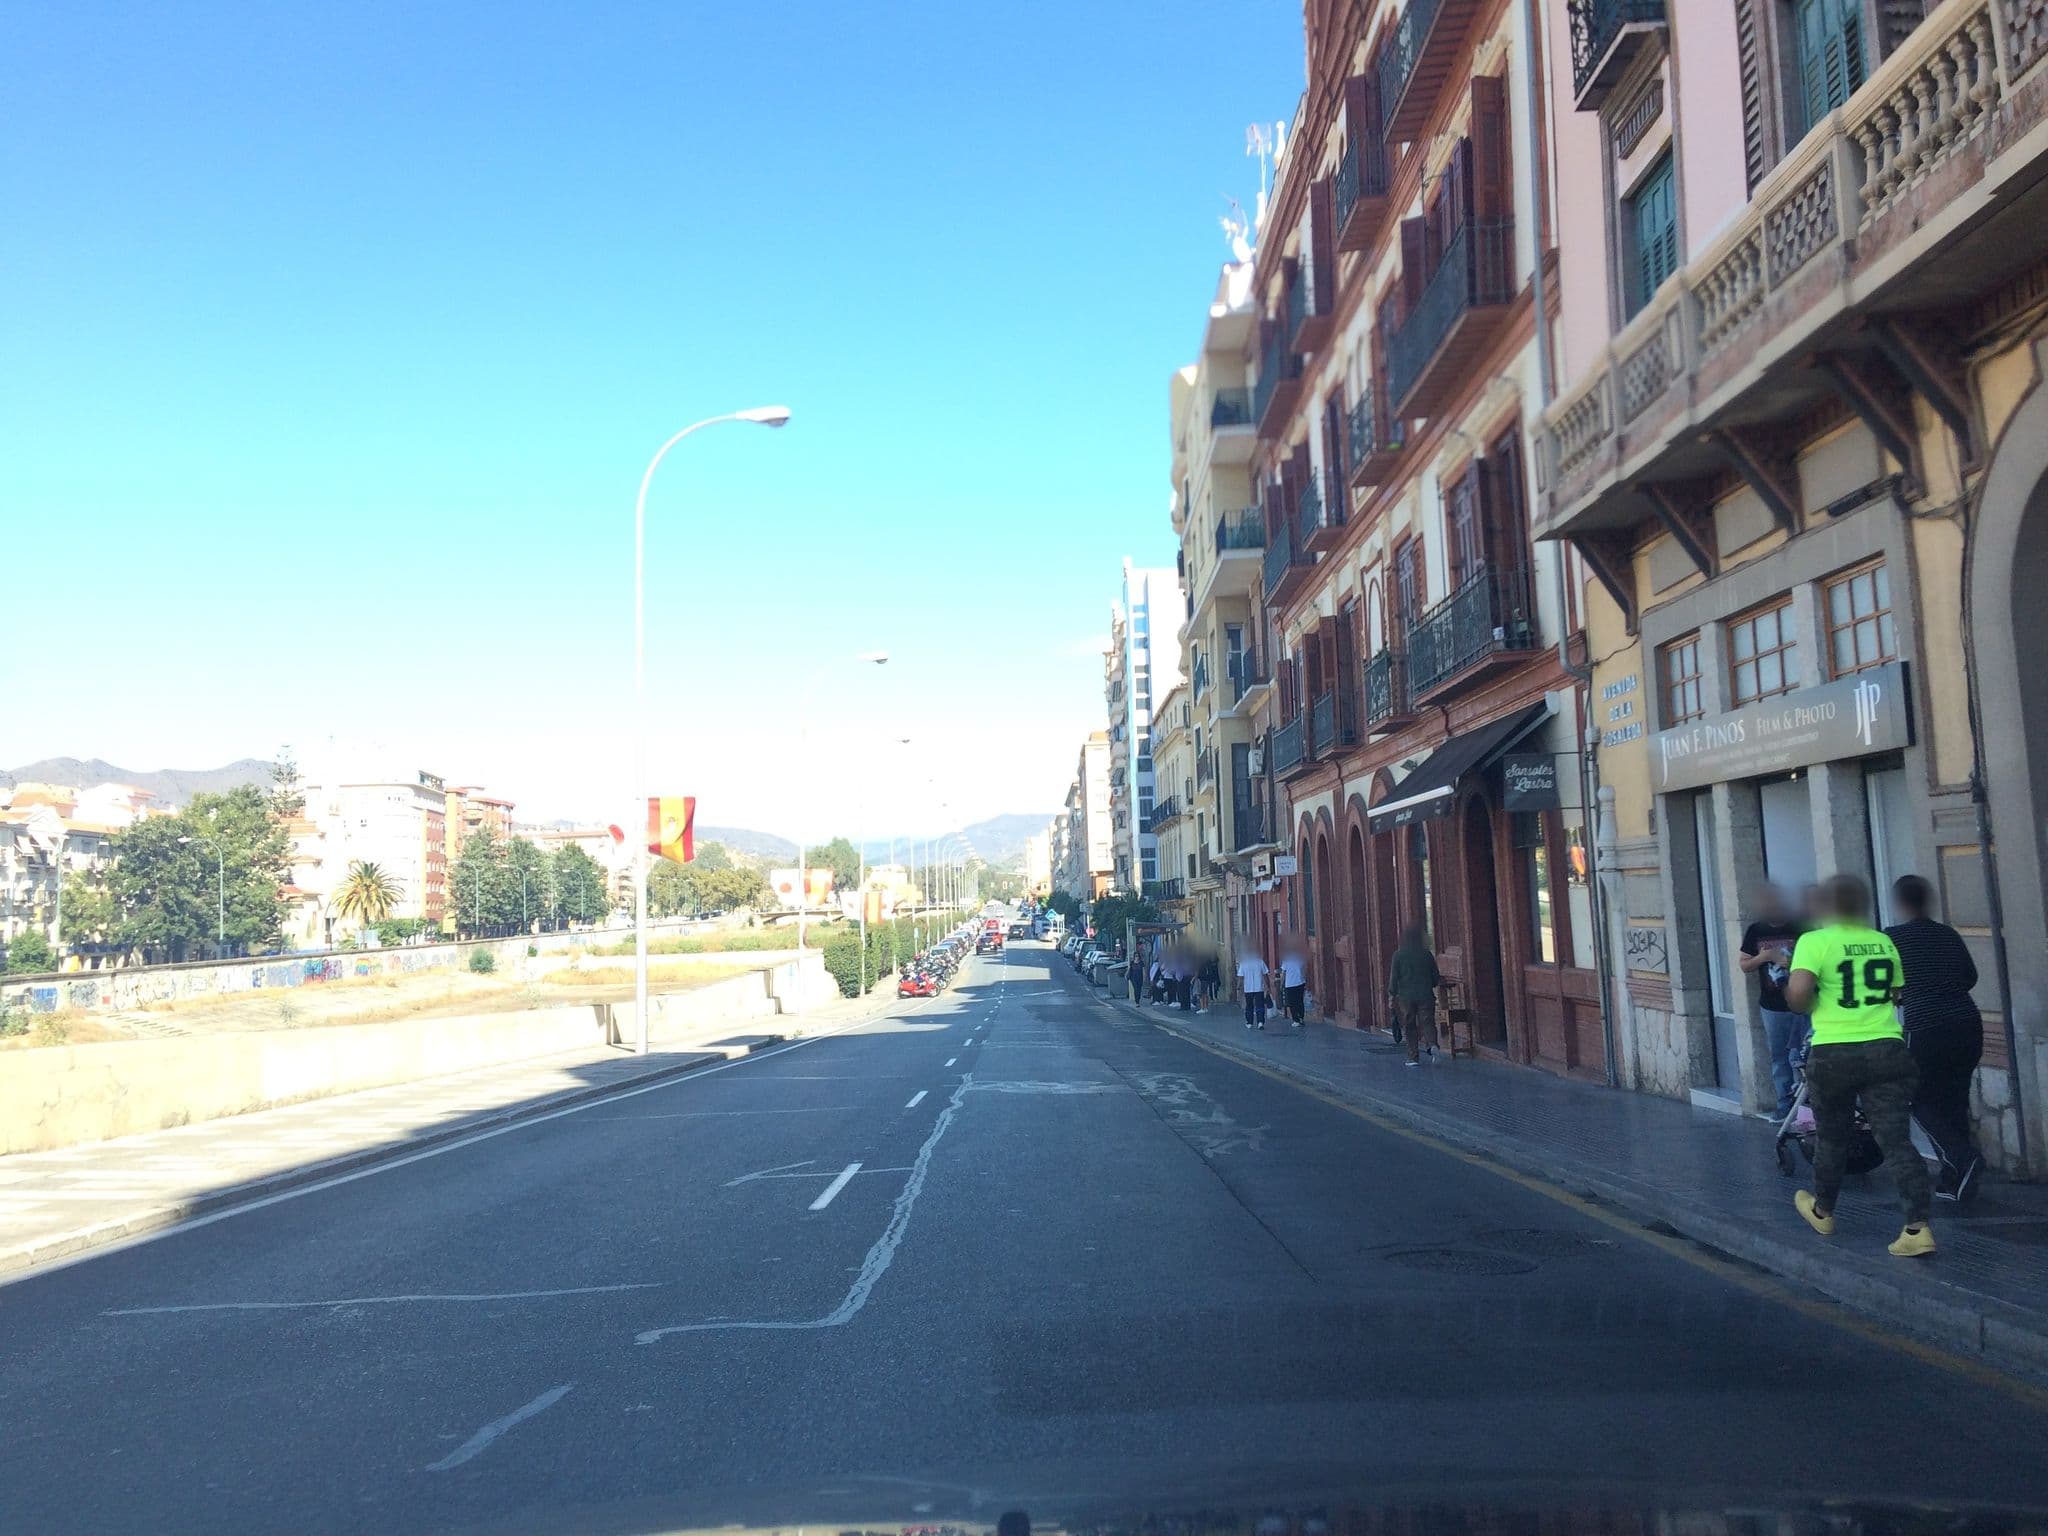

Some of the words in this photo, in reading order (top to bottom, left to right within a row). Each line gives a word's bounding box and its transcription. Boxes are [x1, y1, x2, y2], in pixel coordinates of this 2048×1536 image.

[1621, 702, 1632, 718] LA
[1756, 715, 1781, 737] FILM
[1783, 709, 1793, 730] &
[1795, 701, 1836, 727] PHOTO
[1661, 736, 1690, 786] JUAN
[1705, 719, 1745, 750] PINOS
[1843, 943, 1886, 956] MONICA
[1836, 958, 1894, 1009] 19
